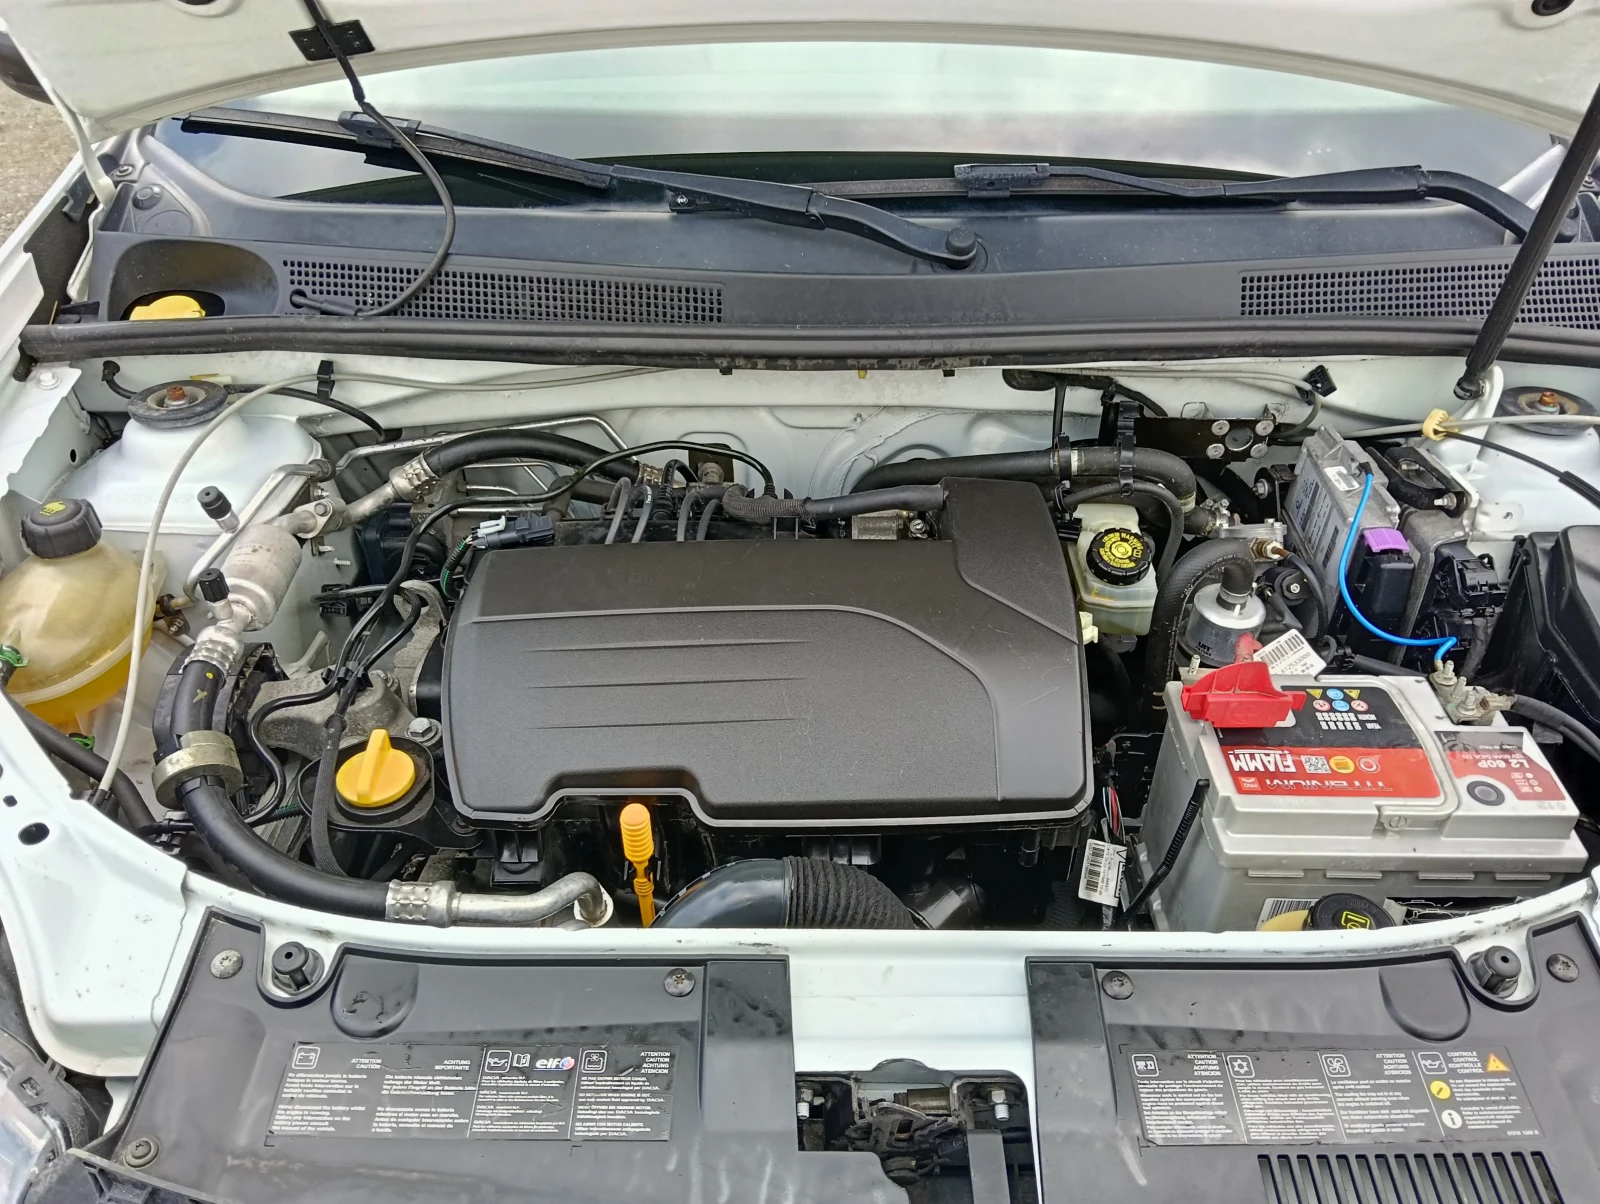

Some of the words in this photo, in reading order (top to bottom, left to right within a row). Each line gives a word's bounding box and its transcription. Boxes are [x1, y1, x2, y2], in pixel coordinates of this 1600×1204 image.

[1229, 752, 1297, 773] FIAMM
[1477, 759, 1506, 768] 60P
[1508, 759, 1530, 768] L2
